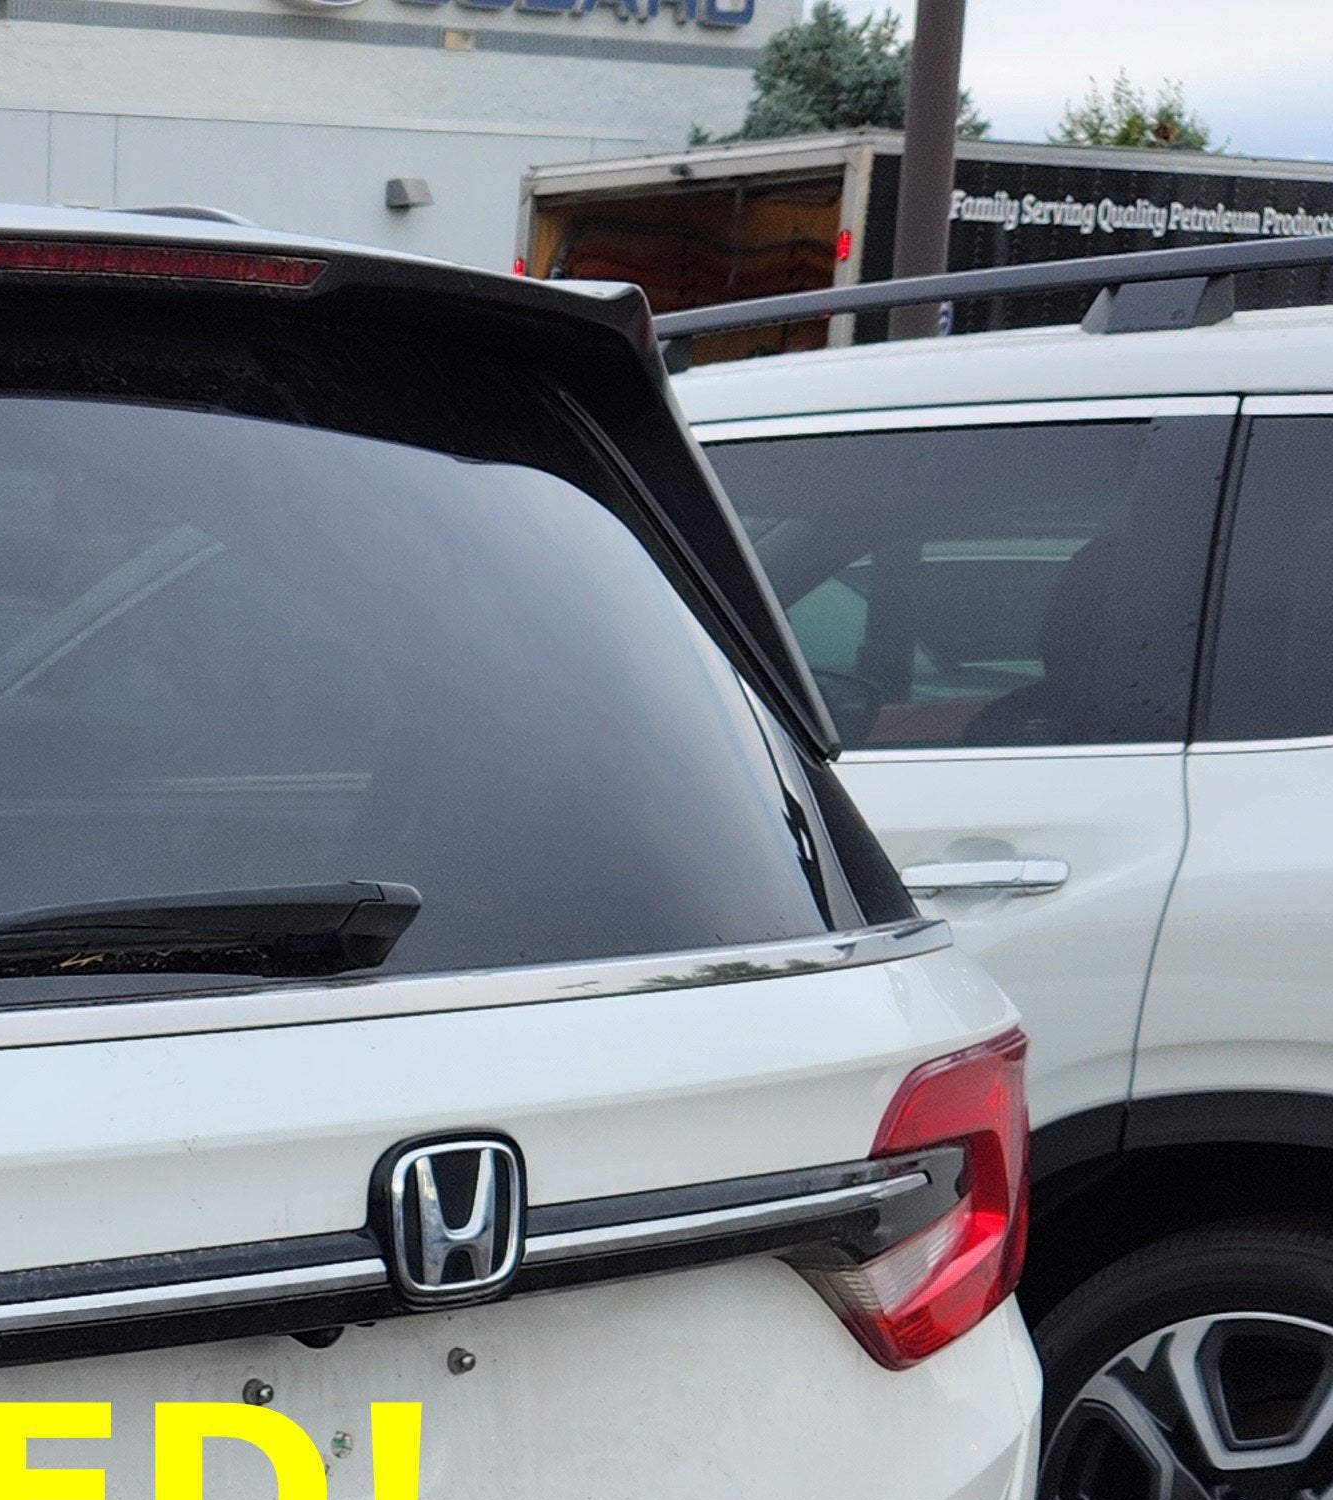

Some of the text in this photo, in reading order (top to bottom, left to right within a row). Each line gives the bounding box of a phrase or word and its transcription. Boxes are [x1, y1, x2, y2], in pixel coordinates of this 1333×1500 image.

[948, 189, 1020, 231] Family
[1020, 194, 1097, 235] Serving
[1097, 197, 1168, 238] Quality
[1168, 201, 1261, 235] Petroleum
